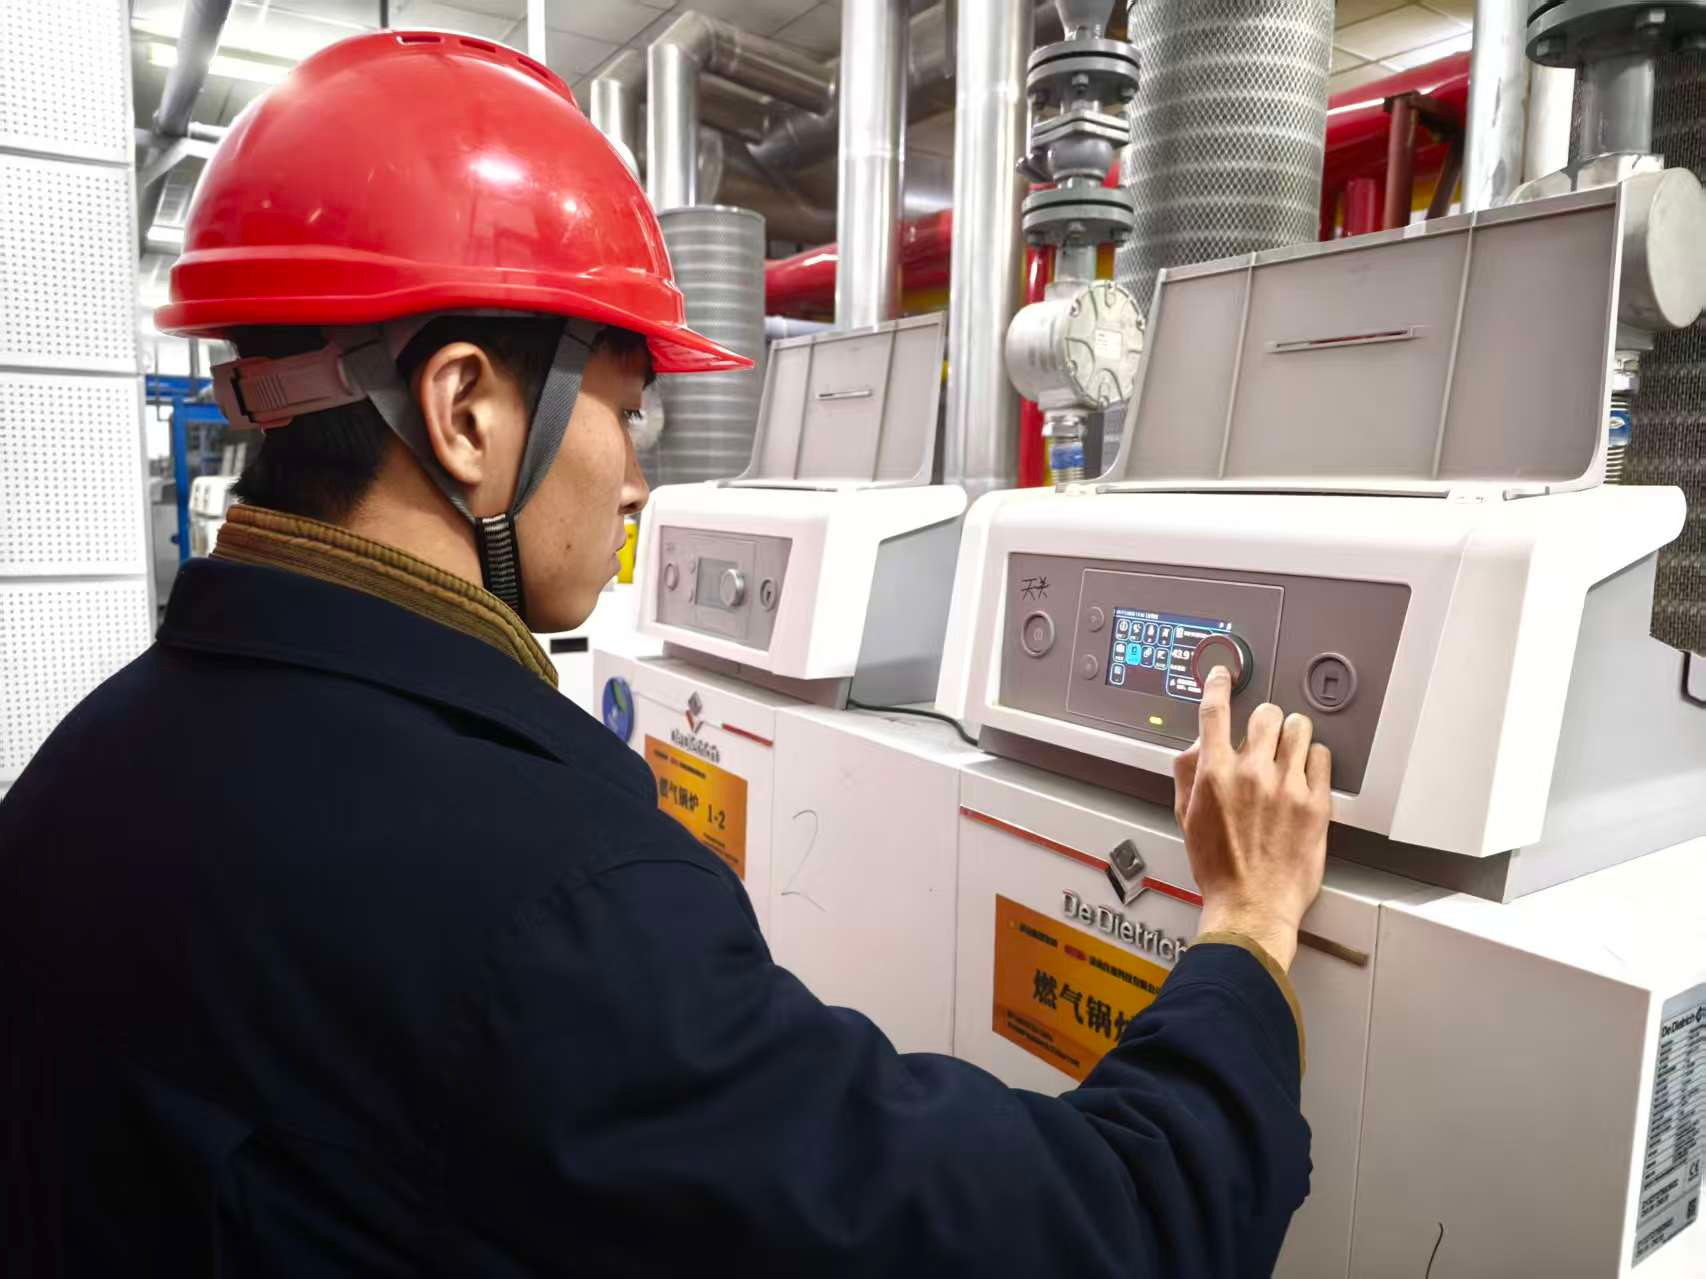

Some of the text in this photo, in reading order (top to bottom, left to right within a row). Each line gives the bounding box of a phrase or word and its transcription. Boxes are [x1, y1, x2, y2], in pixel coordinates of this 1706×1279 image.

[706, 803, 727, 831] 1-2
[1061, 889, 1094, 926] De
[1096, 904, 1189, 964] Dietrich
